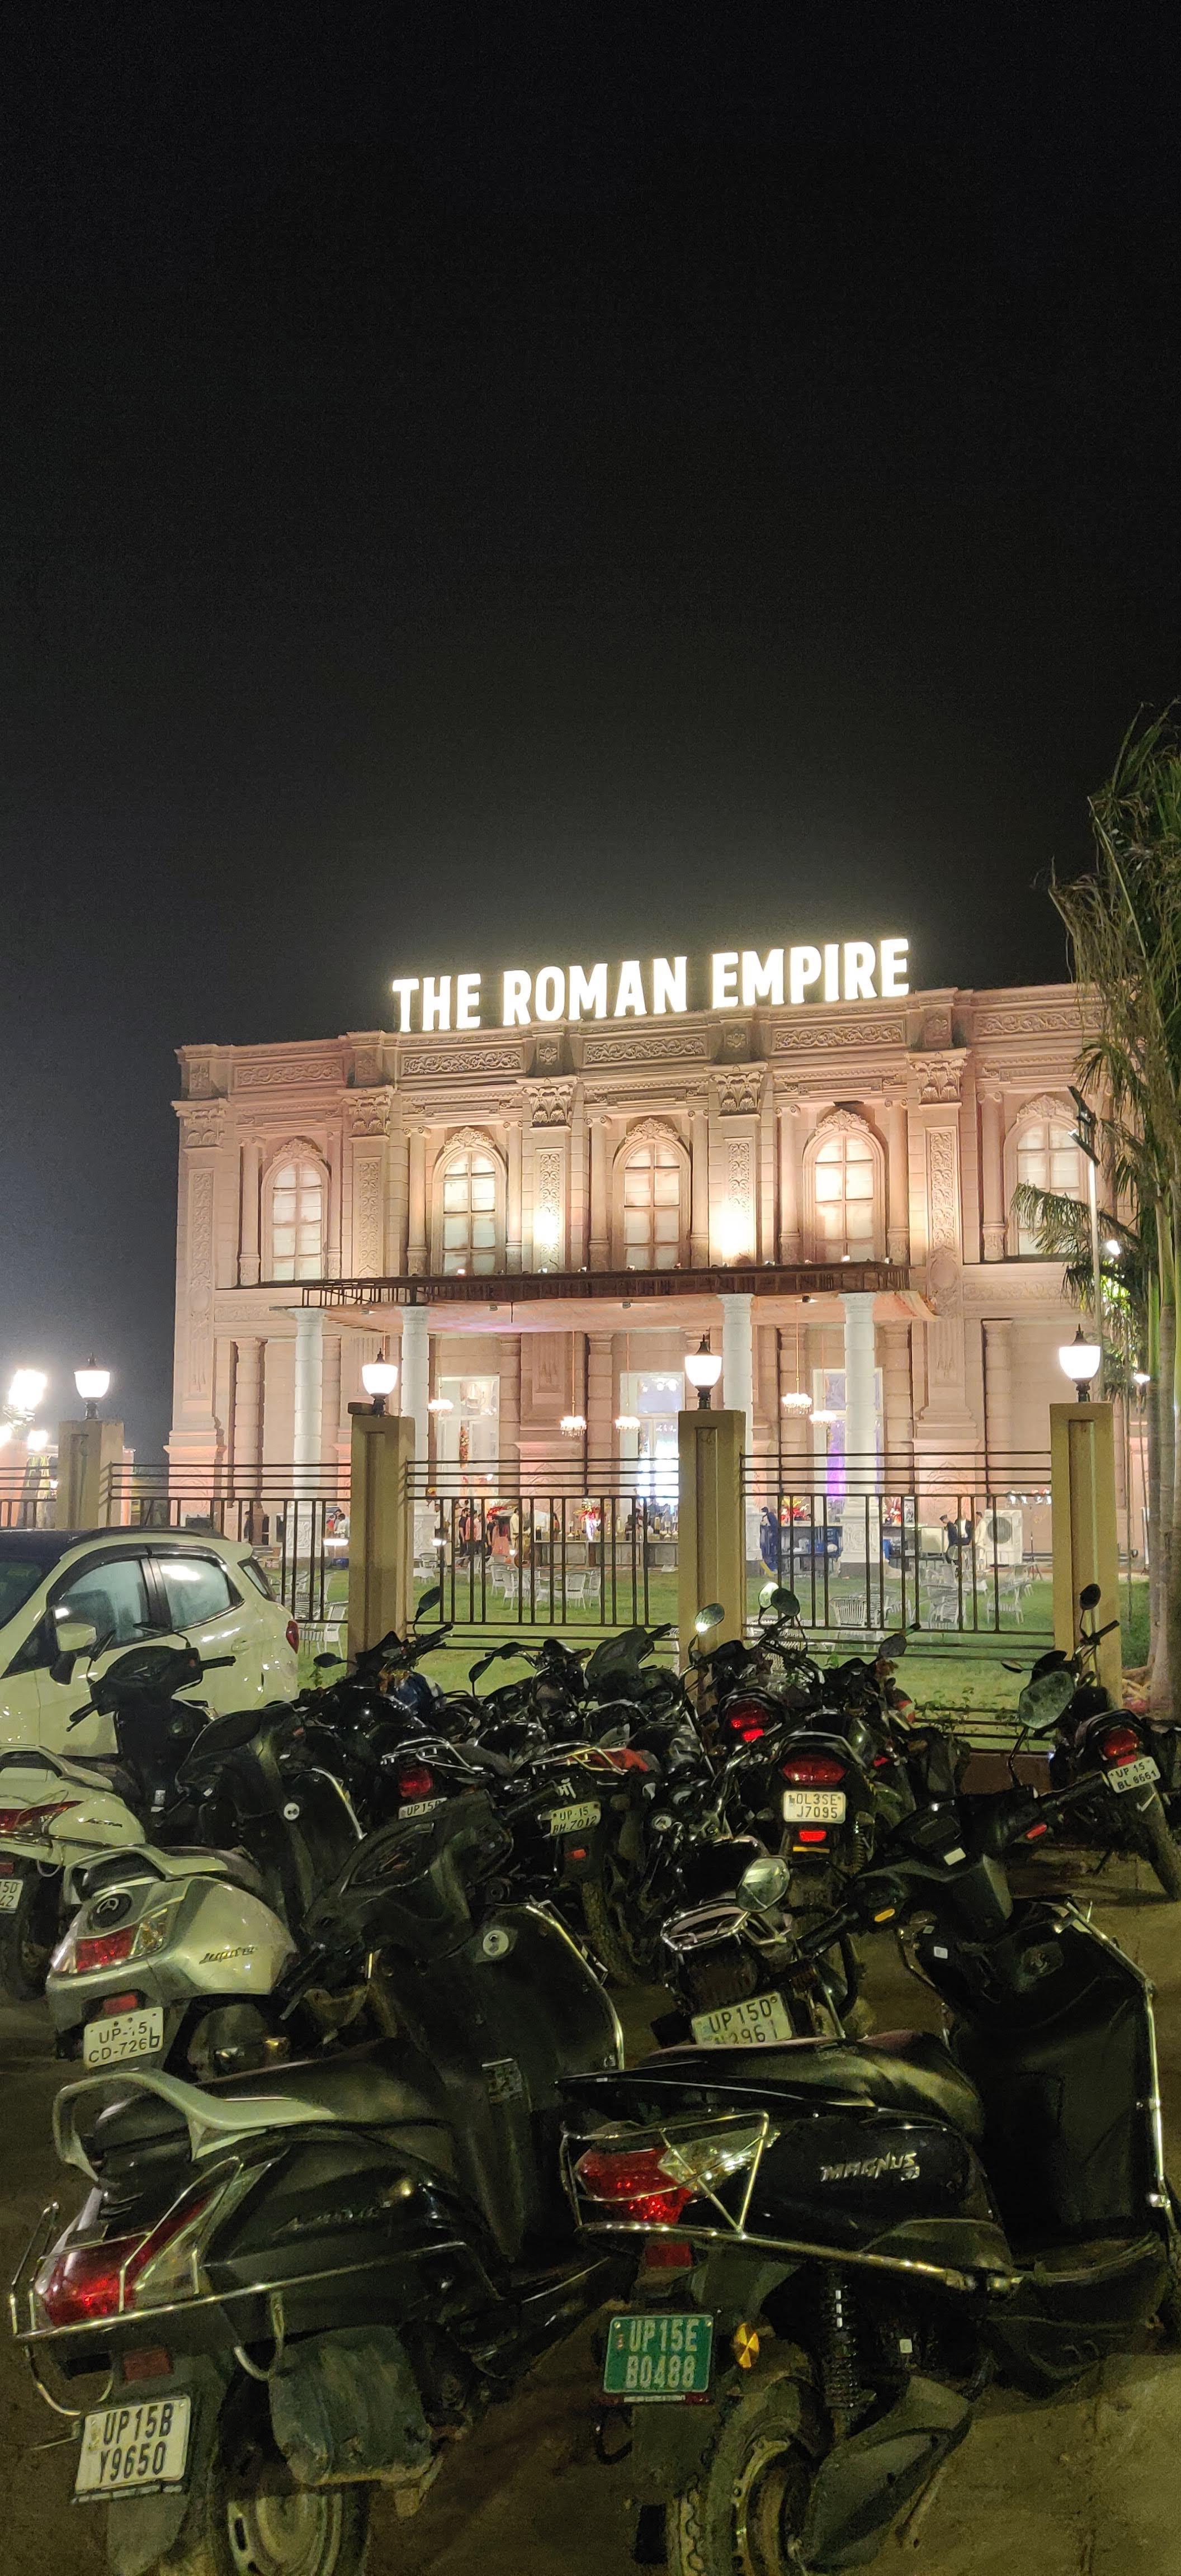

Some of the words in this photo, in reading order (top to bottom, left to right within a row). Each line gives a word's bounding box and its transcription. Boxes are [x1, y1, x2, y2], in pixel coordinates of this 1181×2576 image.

[392, 973, 481, 1033] THE
[503, 956, 687, 1026] ROMAN
[712, 939, 909, 1009] EMPIRE
[1116, 1767, 1129, 1778] UP
[1133, 1762, 1145, 1773] 15
[1117, 1780, 1131, 1790] BL
[796, 1793, 838, 1806] DL3SE
[796, 1806, 838, 1819] J7095
[708, 1999, 772, 2033] UP15D
[630, 2318, 699, 2352] UP15E
[626, 2355, 696, 2389] B0488
[103, 2403, 174, 2445] UP15B
[100, 2441, 166, 2484] Y9650
